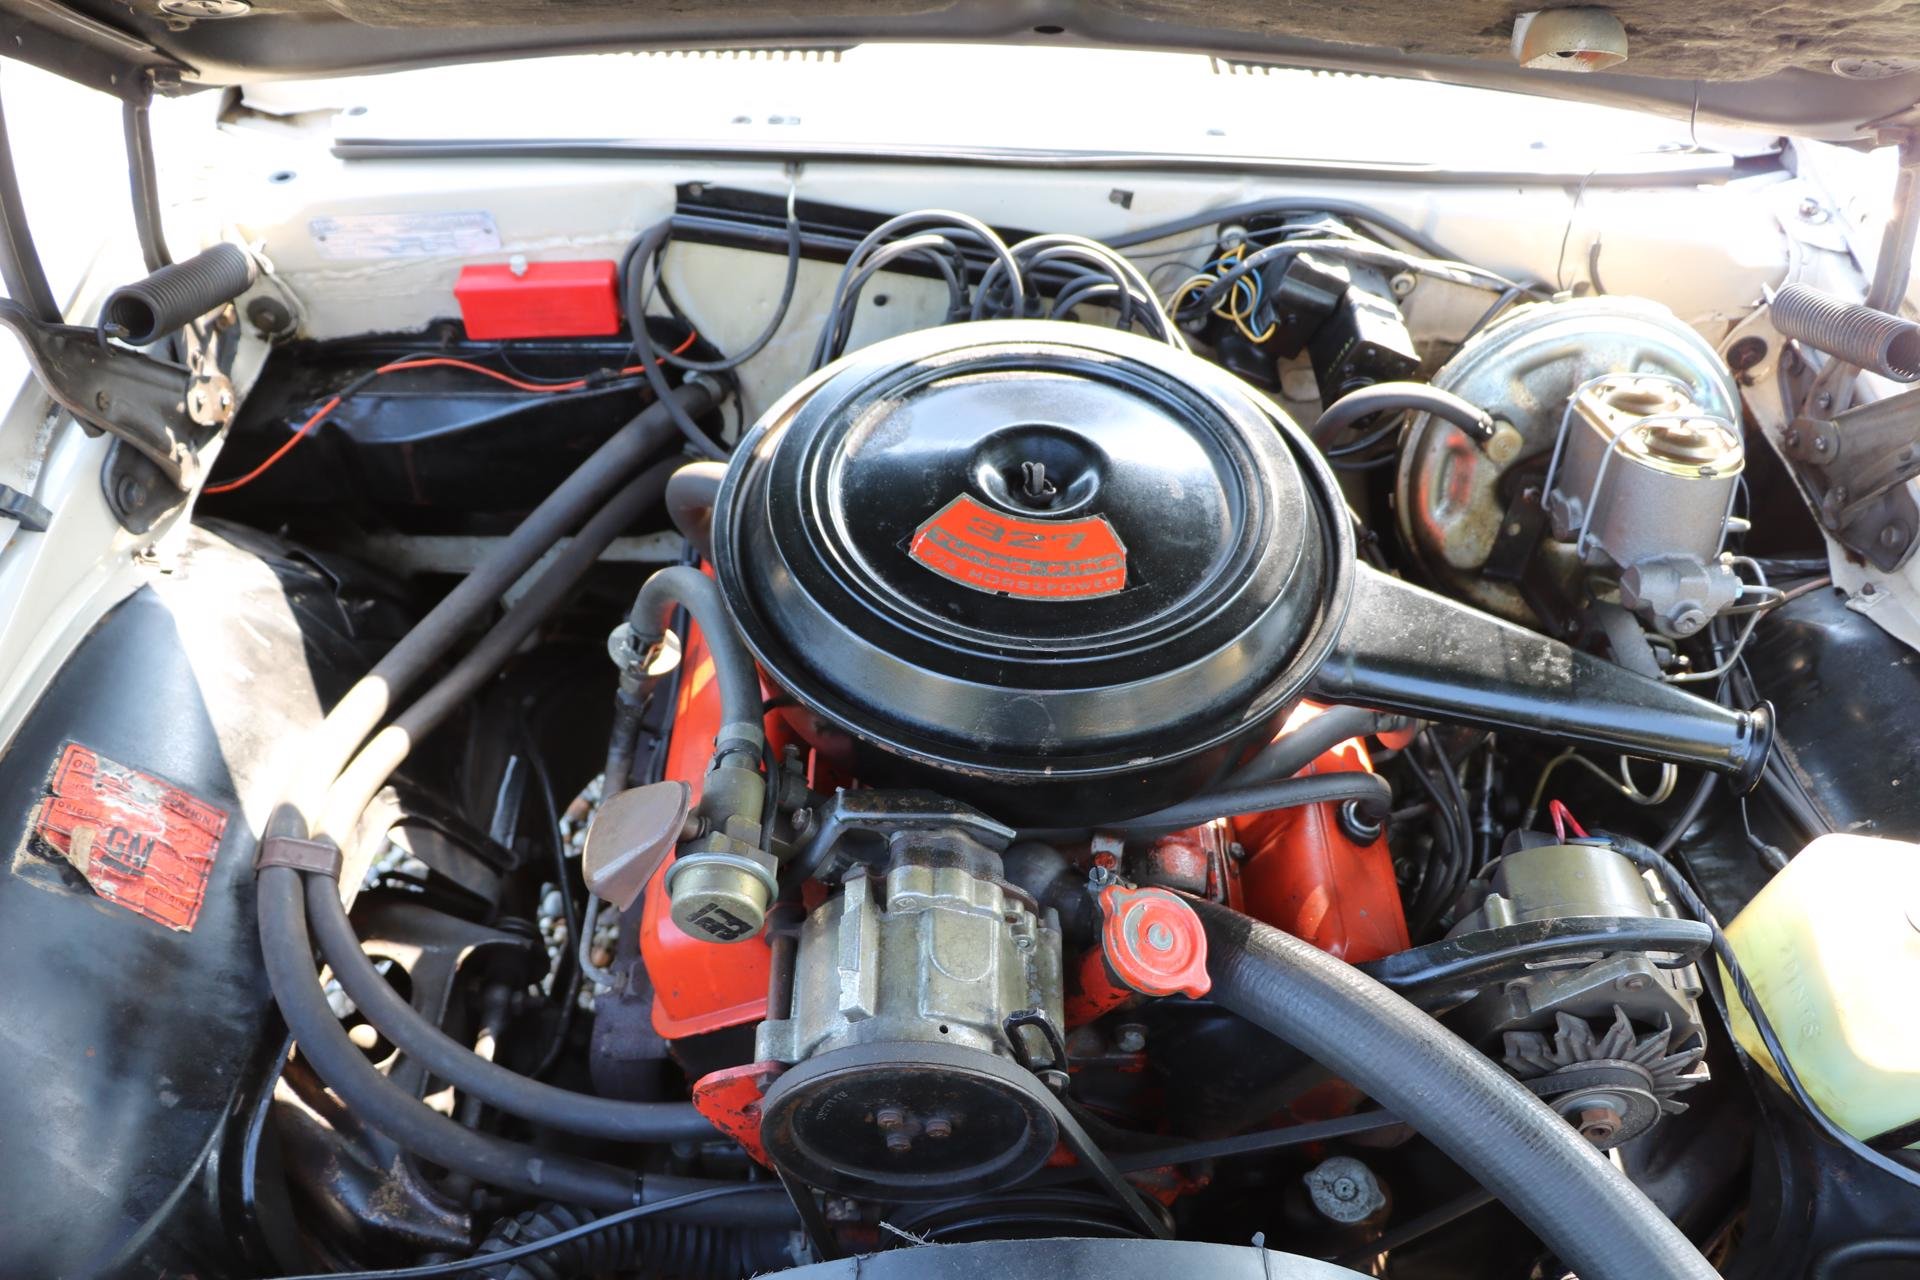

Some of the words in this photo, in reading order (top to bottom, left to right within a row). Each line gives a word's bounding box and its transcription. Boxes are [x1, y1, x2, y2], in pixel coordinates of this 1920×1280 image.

[965, 517, 1088, 550] 327
[968, 568, 1118, 592] HORSEPOWER
[106, 826, 155, 869] GM
